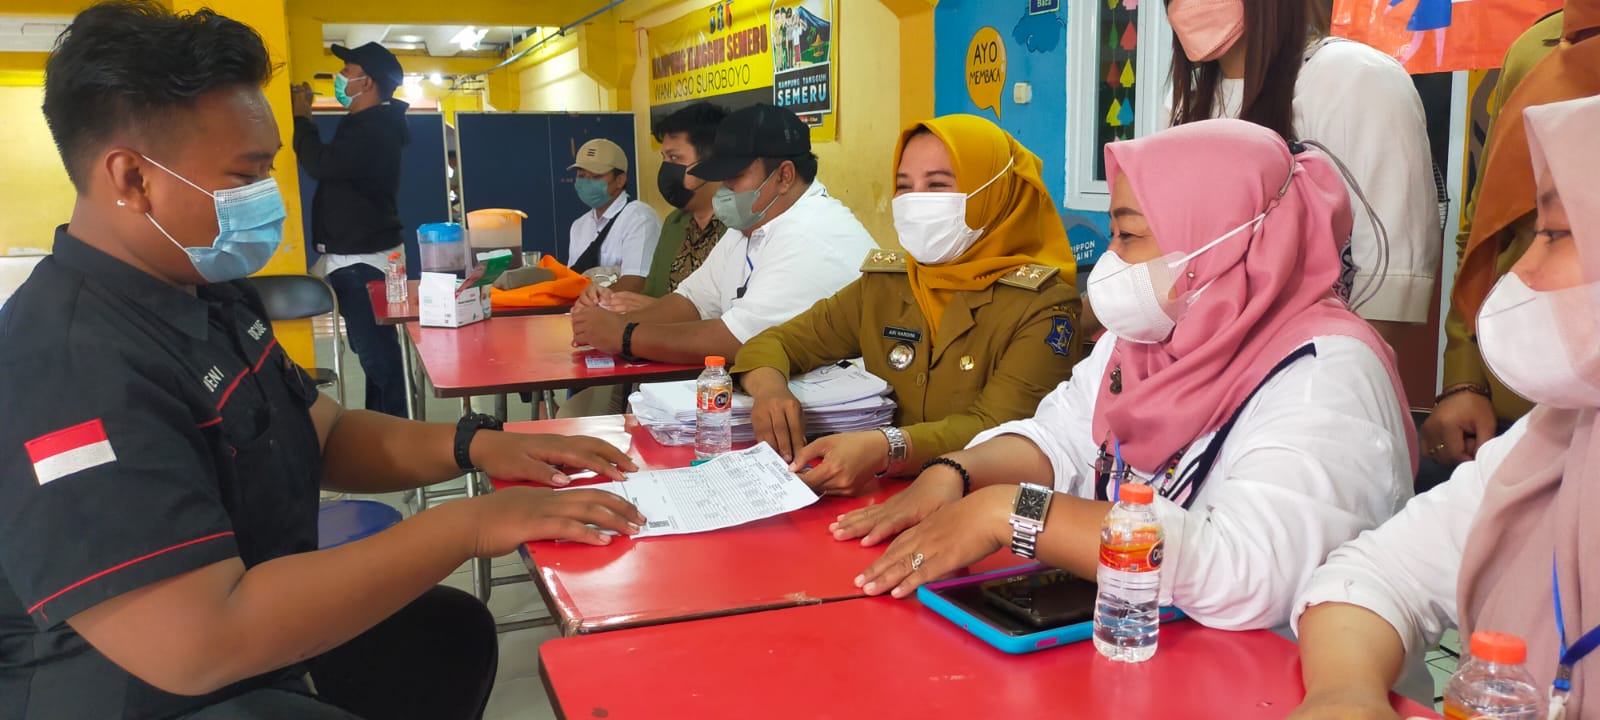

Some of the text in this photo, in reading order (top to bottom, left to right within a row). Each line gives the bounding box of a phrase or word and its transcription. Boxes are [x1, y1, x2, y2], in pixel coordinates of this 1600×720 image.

[727, 24, 768, 61] SEMERU
[973, 41, 998, 66] AYO
[697, 64, 751, 94] SUROBOYO
[777, 83, 827, 107] SEMERU
[1071, 240, 1095, 253] IPPON
